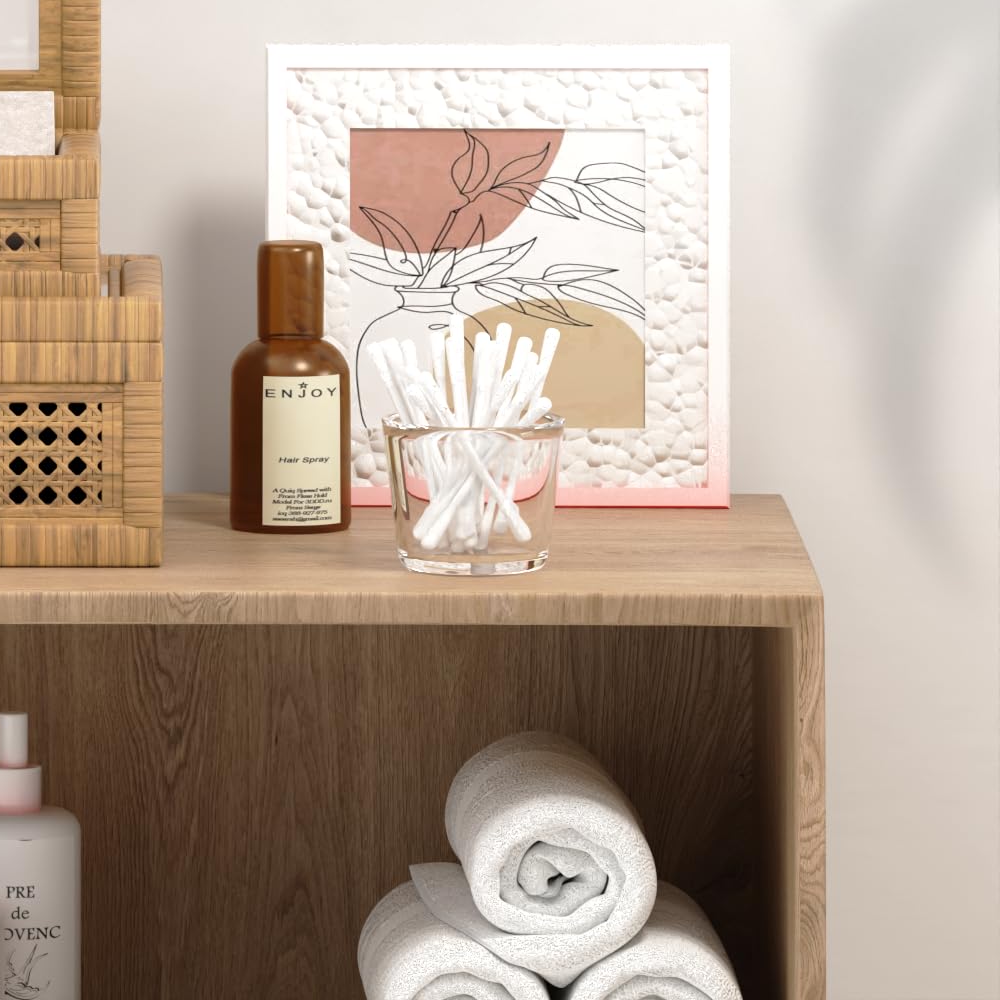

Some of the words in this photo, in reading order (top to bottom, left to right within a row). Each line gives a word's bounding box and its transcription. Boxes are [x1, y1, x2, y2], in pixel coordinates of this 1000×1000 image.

[265, 388, 337, 398] ENJOY
[302, 456, 330, 465] Spray
[6, 885, 35, 899] PRE
[11, 906, 30, 920] de
